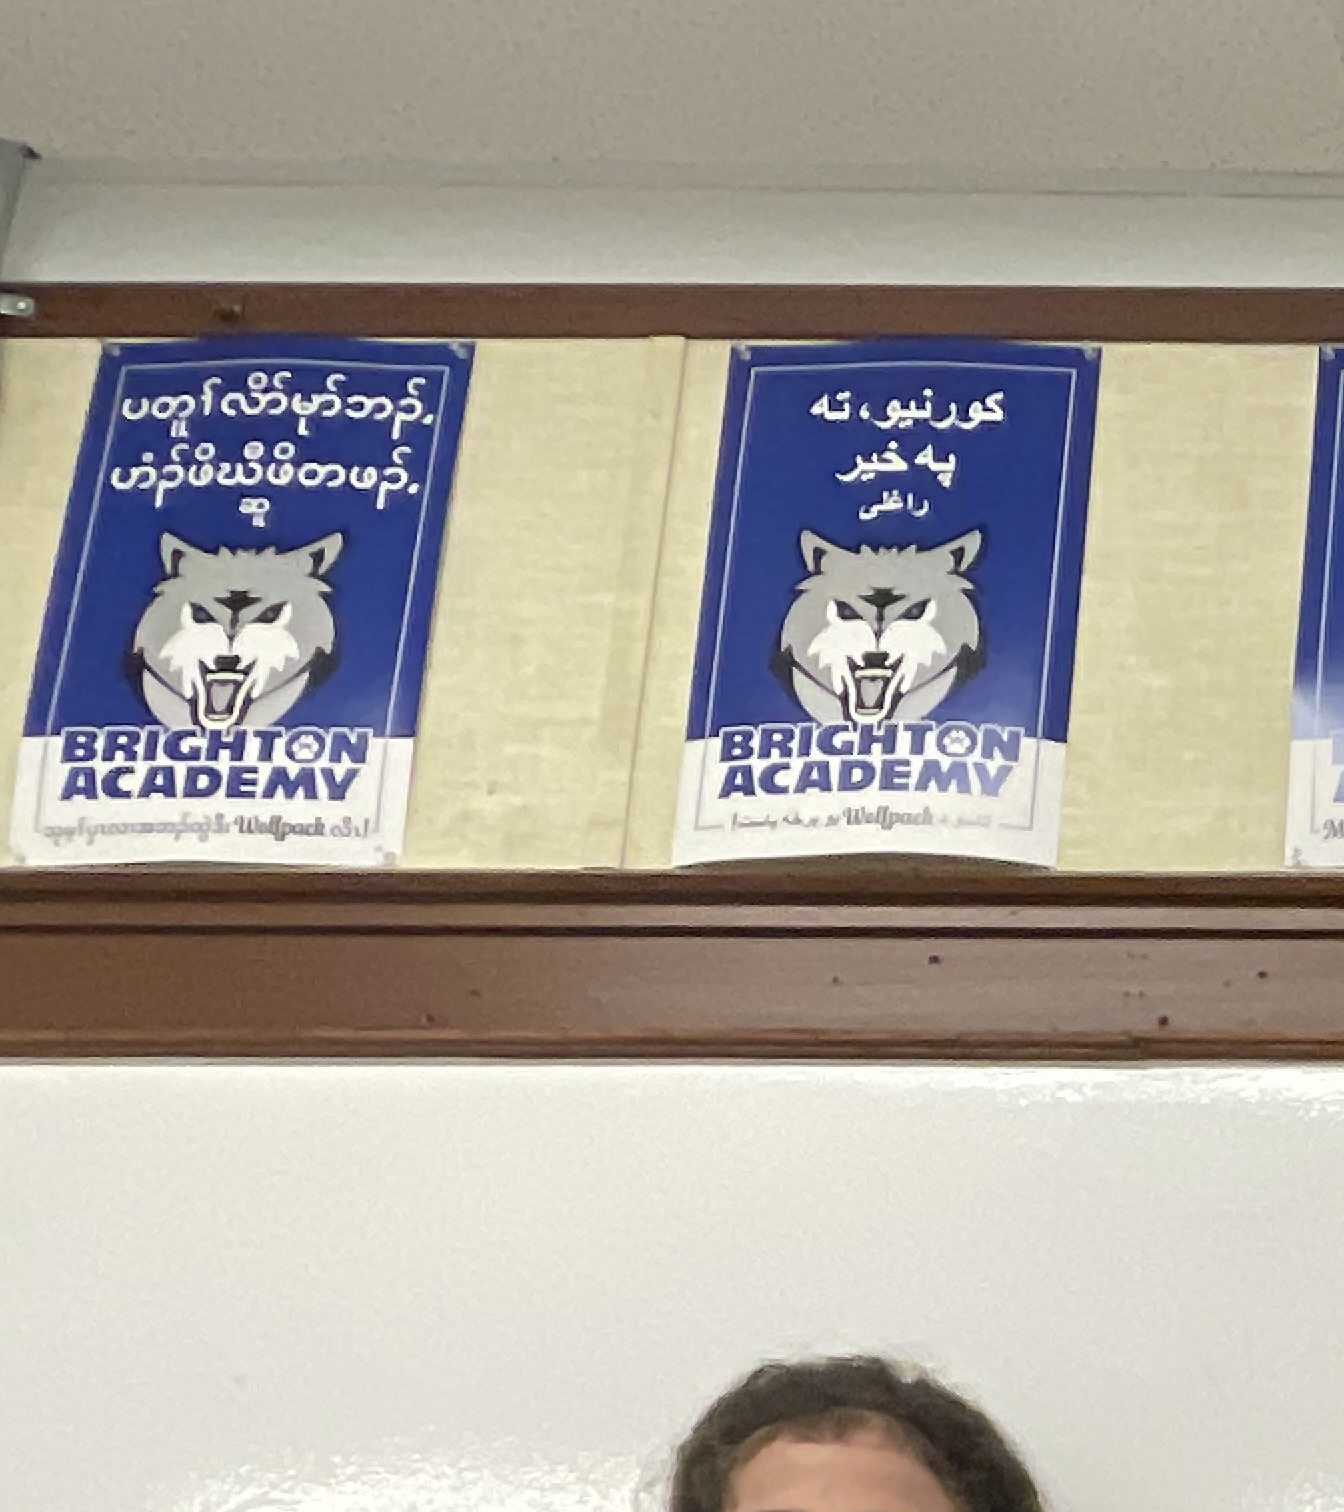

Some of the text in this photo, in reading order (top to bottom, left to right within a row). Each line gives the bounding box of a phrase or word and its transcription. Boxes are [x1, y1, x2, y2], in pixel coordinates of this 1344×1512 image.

[60, 725, 373, 766] BRIGHTON
[717, 721, 1025, 763] BRIGHTON
[60, 766, 363, 801] ACADEMY
[718, 760, 1015, 799] ACADEMY
